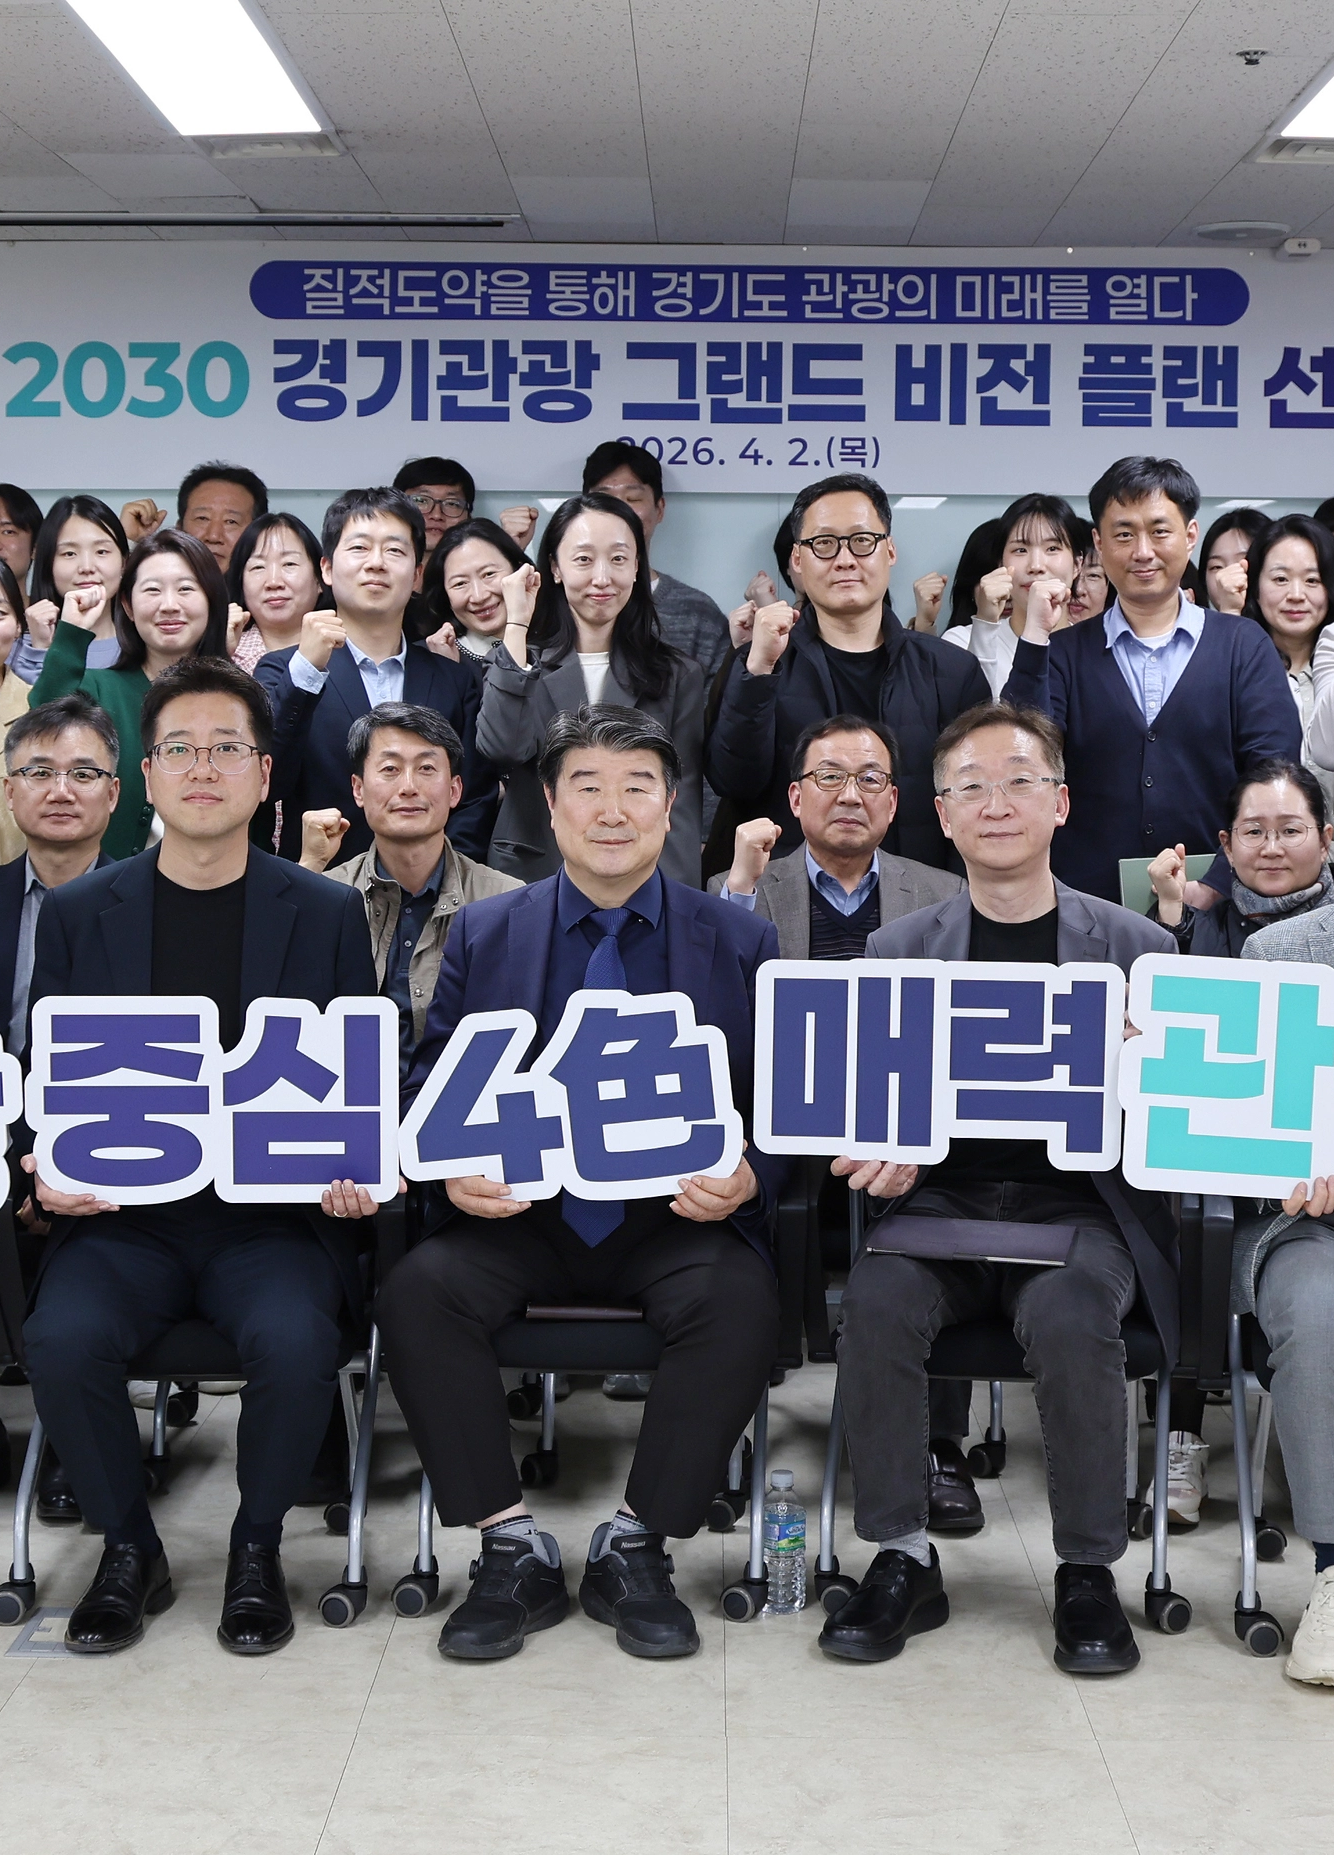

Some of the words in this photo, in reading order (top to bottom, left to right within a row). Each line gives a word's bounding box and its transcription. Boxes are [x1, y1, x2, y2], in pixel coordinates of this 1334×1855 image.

[302, 267, 533, 316] 질적도약을
[545, 269, 636, 318] 통해
[651, 270, 789, 319] 경기도
[801, 272, 938, 321] 관광의
[955, 273, 1091, 321] 미래를
[1105, 273, 1199, 322] 열다
[1, 339, 252, 420] 2030
[271, 337, 602, 425] 경기관광
[621, 340, 867, 425] 그랜드
[893, 342, 1052, 427] 비전
[1077, 342, 1240, 429] 플랜
[738, 436, 774, 467] 4.
[41, 1012, 382, 1188] 중심
[415, 1006, 727, 1185] 4色
[770, 975, 1105, 1156] 매력
[491, 1542, 517, 1552] Nassau
